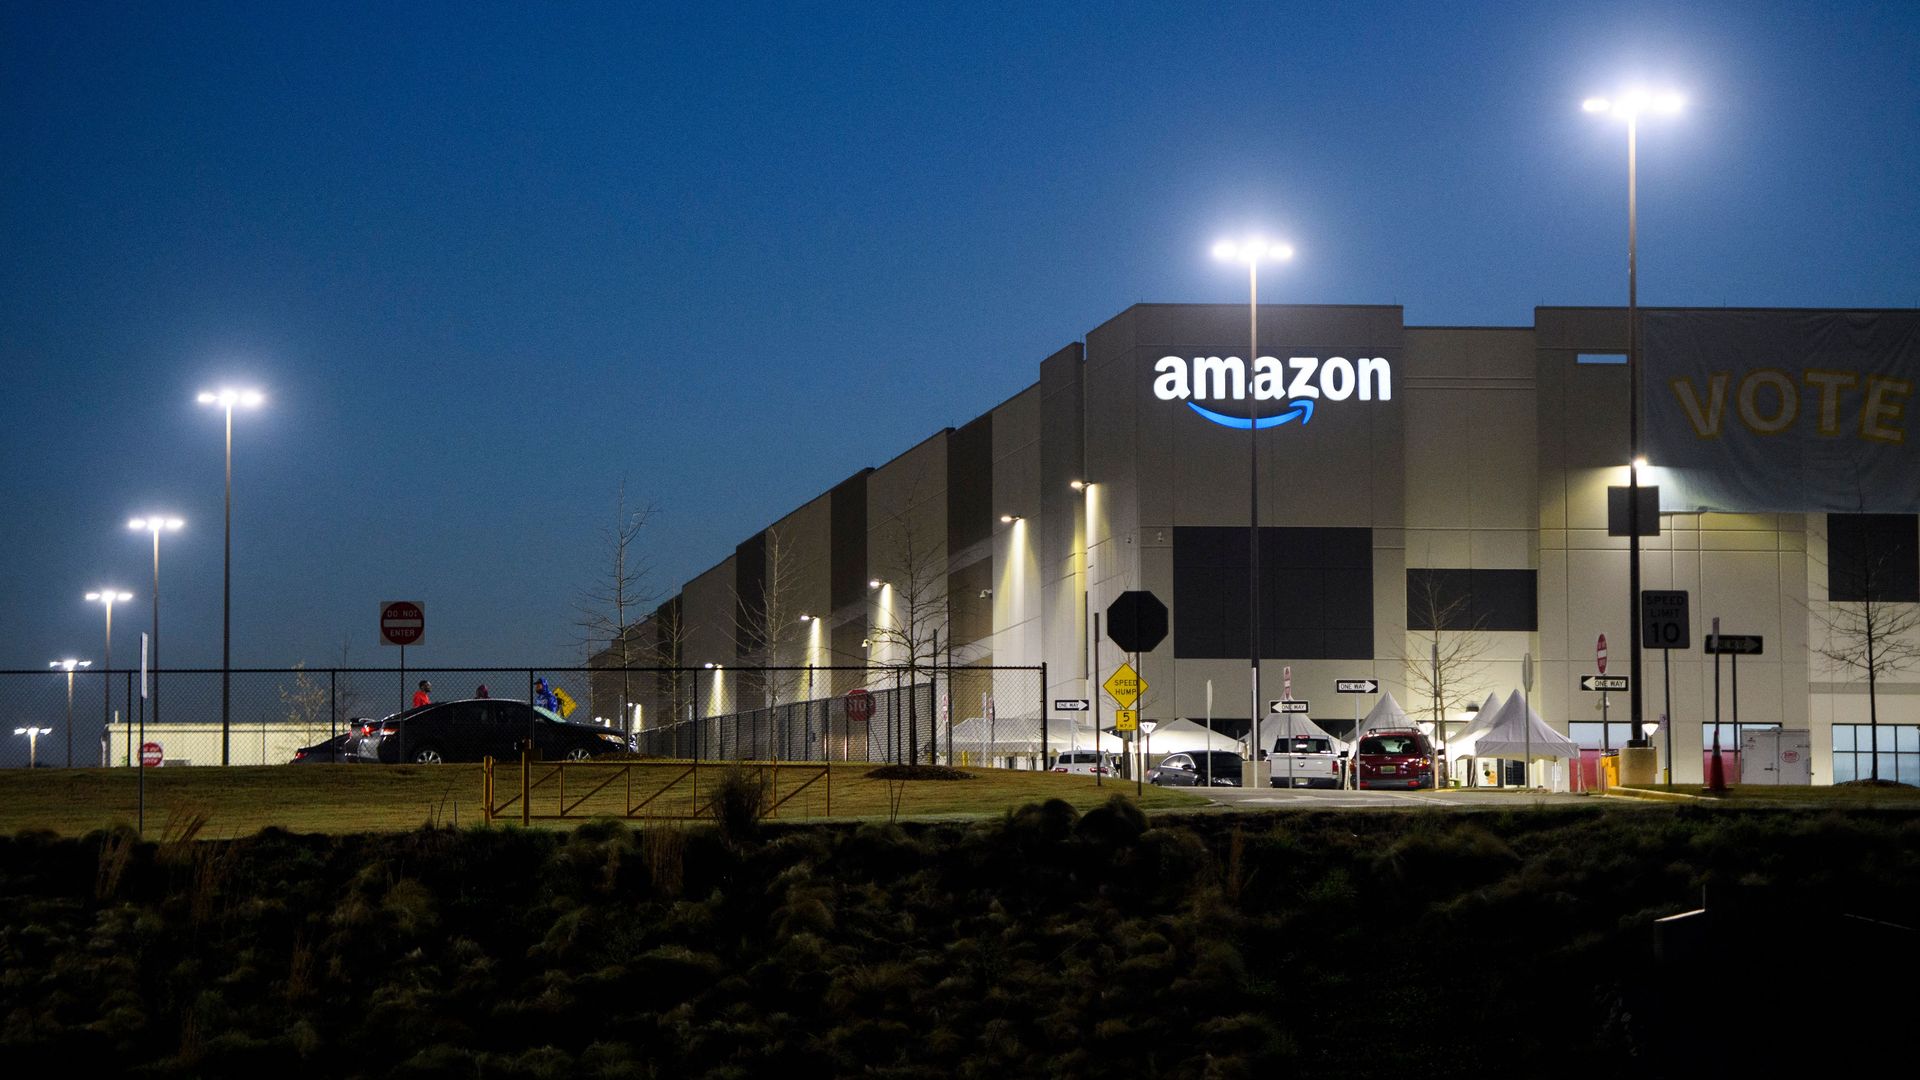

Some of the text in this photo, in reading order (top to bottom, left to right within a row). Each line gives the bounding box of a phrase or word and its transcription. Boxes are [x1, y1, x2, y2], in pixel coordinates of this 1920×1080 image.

[1154, 356, 1391, 401] amazon
[1667, 368, 1914, 444] VOTE
[1647, 596, 1684, 605] SPEED
[1650, 608, 1680, 618] LIMIT
[390, 629, 416, 637] ENTER
[1652, 622, 1681, 643] 10
[1123, 712, 1130, 722] 5
